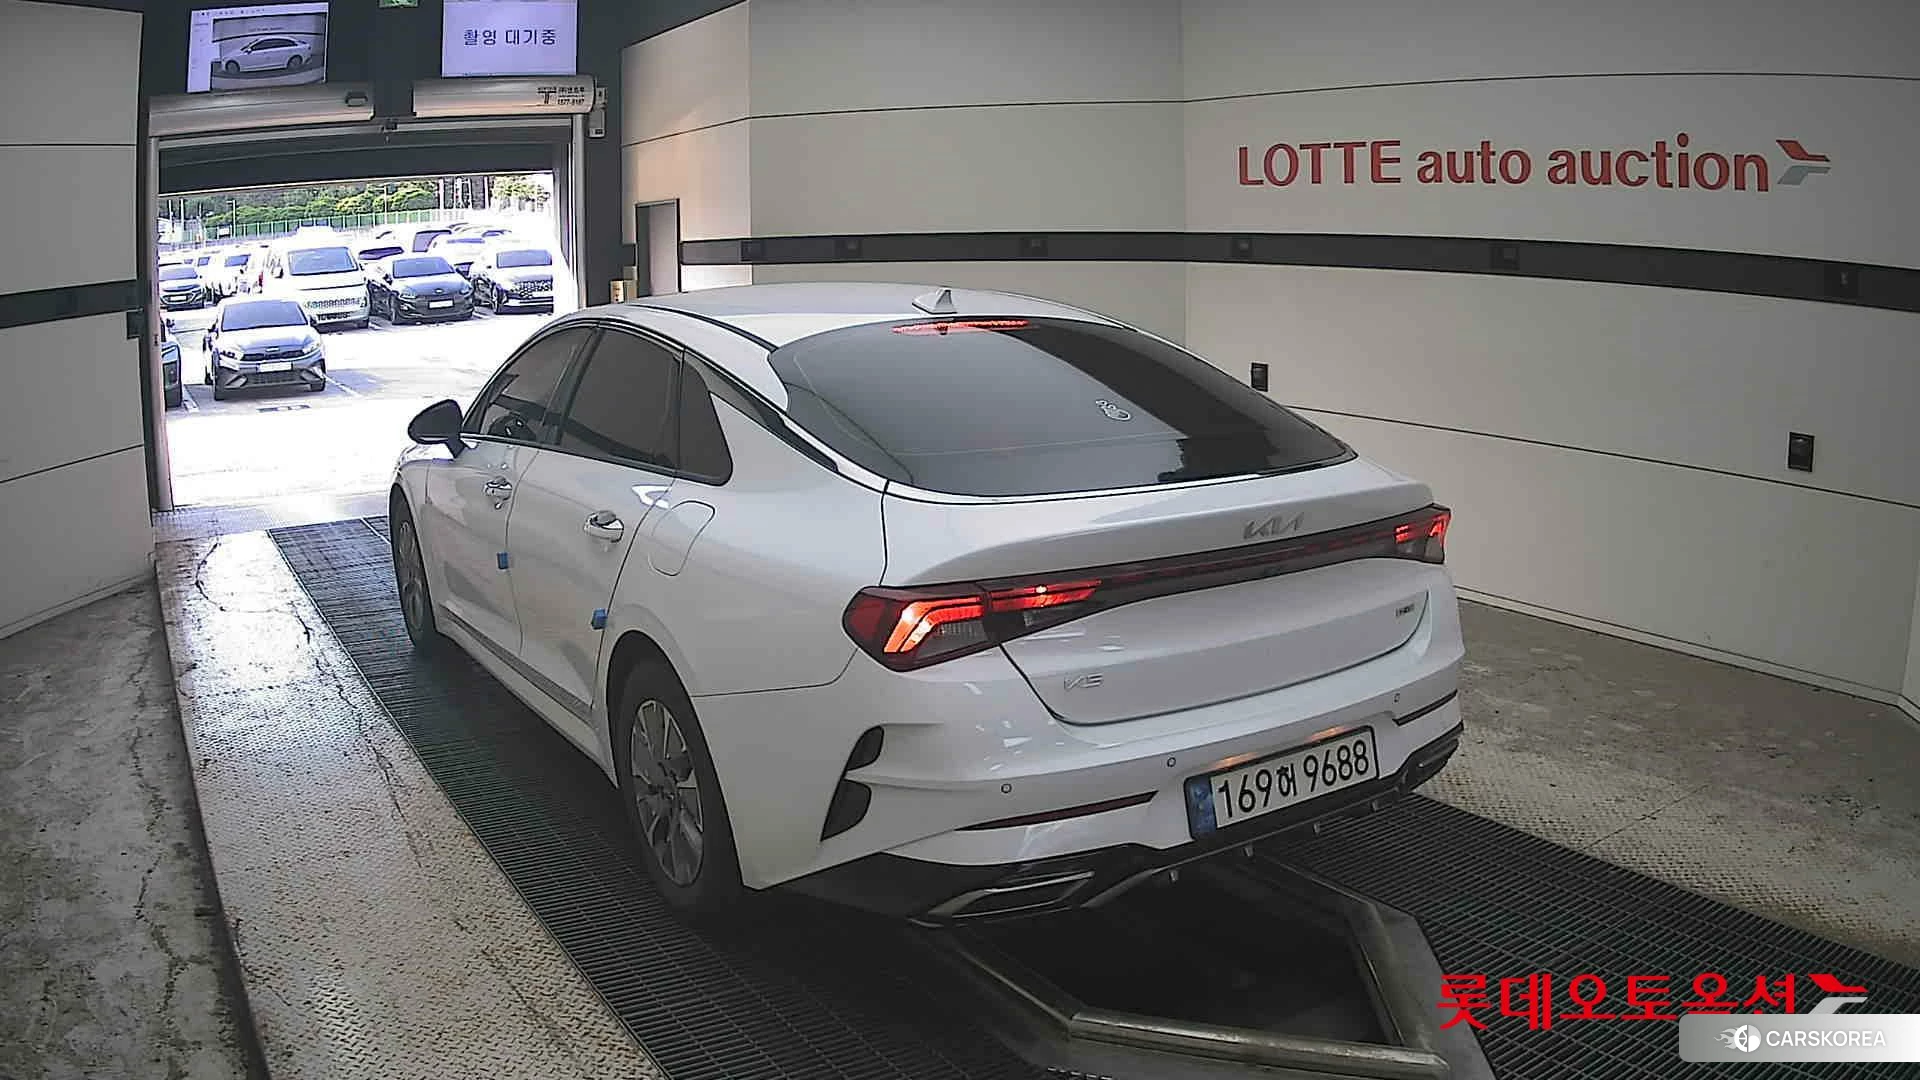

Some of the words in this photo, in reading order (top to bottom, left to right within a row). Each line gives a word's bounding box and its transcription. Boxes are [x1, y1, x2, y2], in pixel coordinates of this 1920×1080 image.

[505, 29, 556, 46] 대기중
[1239, 140, 1401, 186] LOTTE
[1417, 142, 1532, 184] auto
[1548, 133, 1769, 192] auction
[1217, 762, 1298, 818] 169허
[1302, 739, 1370, 793] 9688
